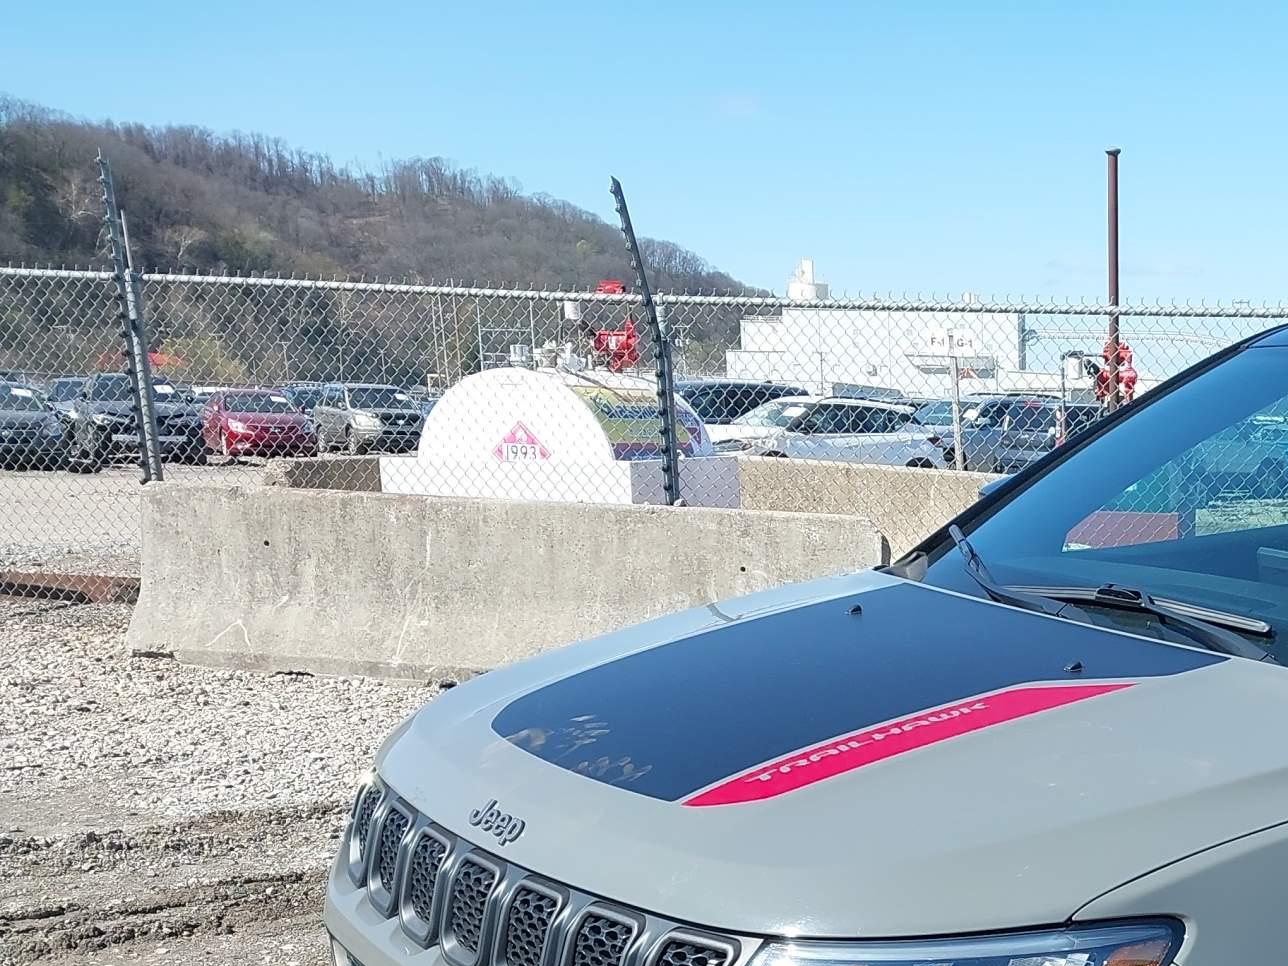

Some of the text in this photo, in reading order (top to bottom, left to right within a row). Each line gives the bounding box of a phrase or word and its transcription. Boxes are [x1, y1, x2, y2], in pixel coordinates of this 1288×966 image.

[930, 336, 945, 346] F-1
[956, 338, 973, 348] G-1
[506, 445, 537, 462] 1993
[744, 702, 991, 782] TRAILHAWK
[469, 799, 526, 847] Jeep
